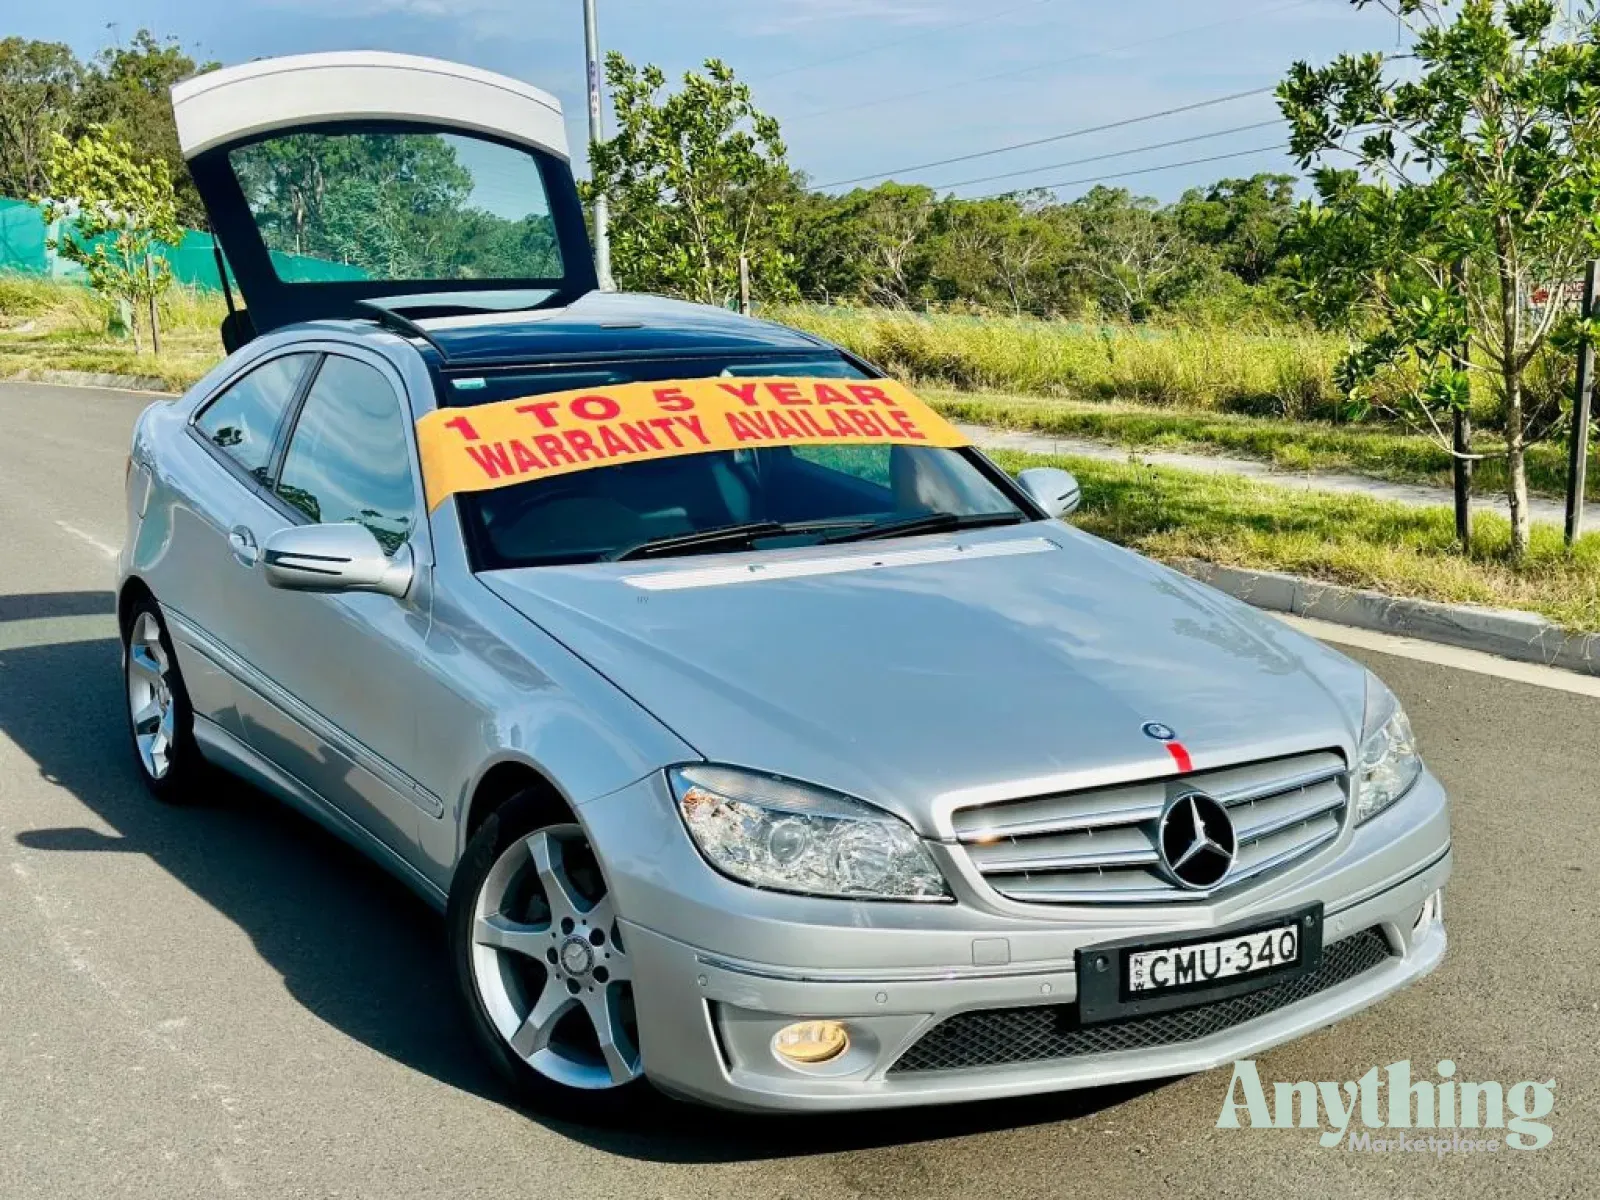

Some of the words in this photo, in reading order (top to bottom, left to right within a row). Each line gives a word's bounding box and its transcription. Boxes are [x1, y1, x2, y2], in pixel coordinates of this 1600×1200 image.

[445, 416, 480, 440] 1
[515, 396, 621, 428] TO
[653, 388, 695, 412] 5
[717, 382, 895, 406] YEAR
[466, 415, 711, 479] WARRANTY
[724, 409, 925, 441] AVAILABLE
